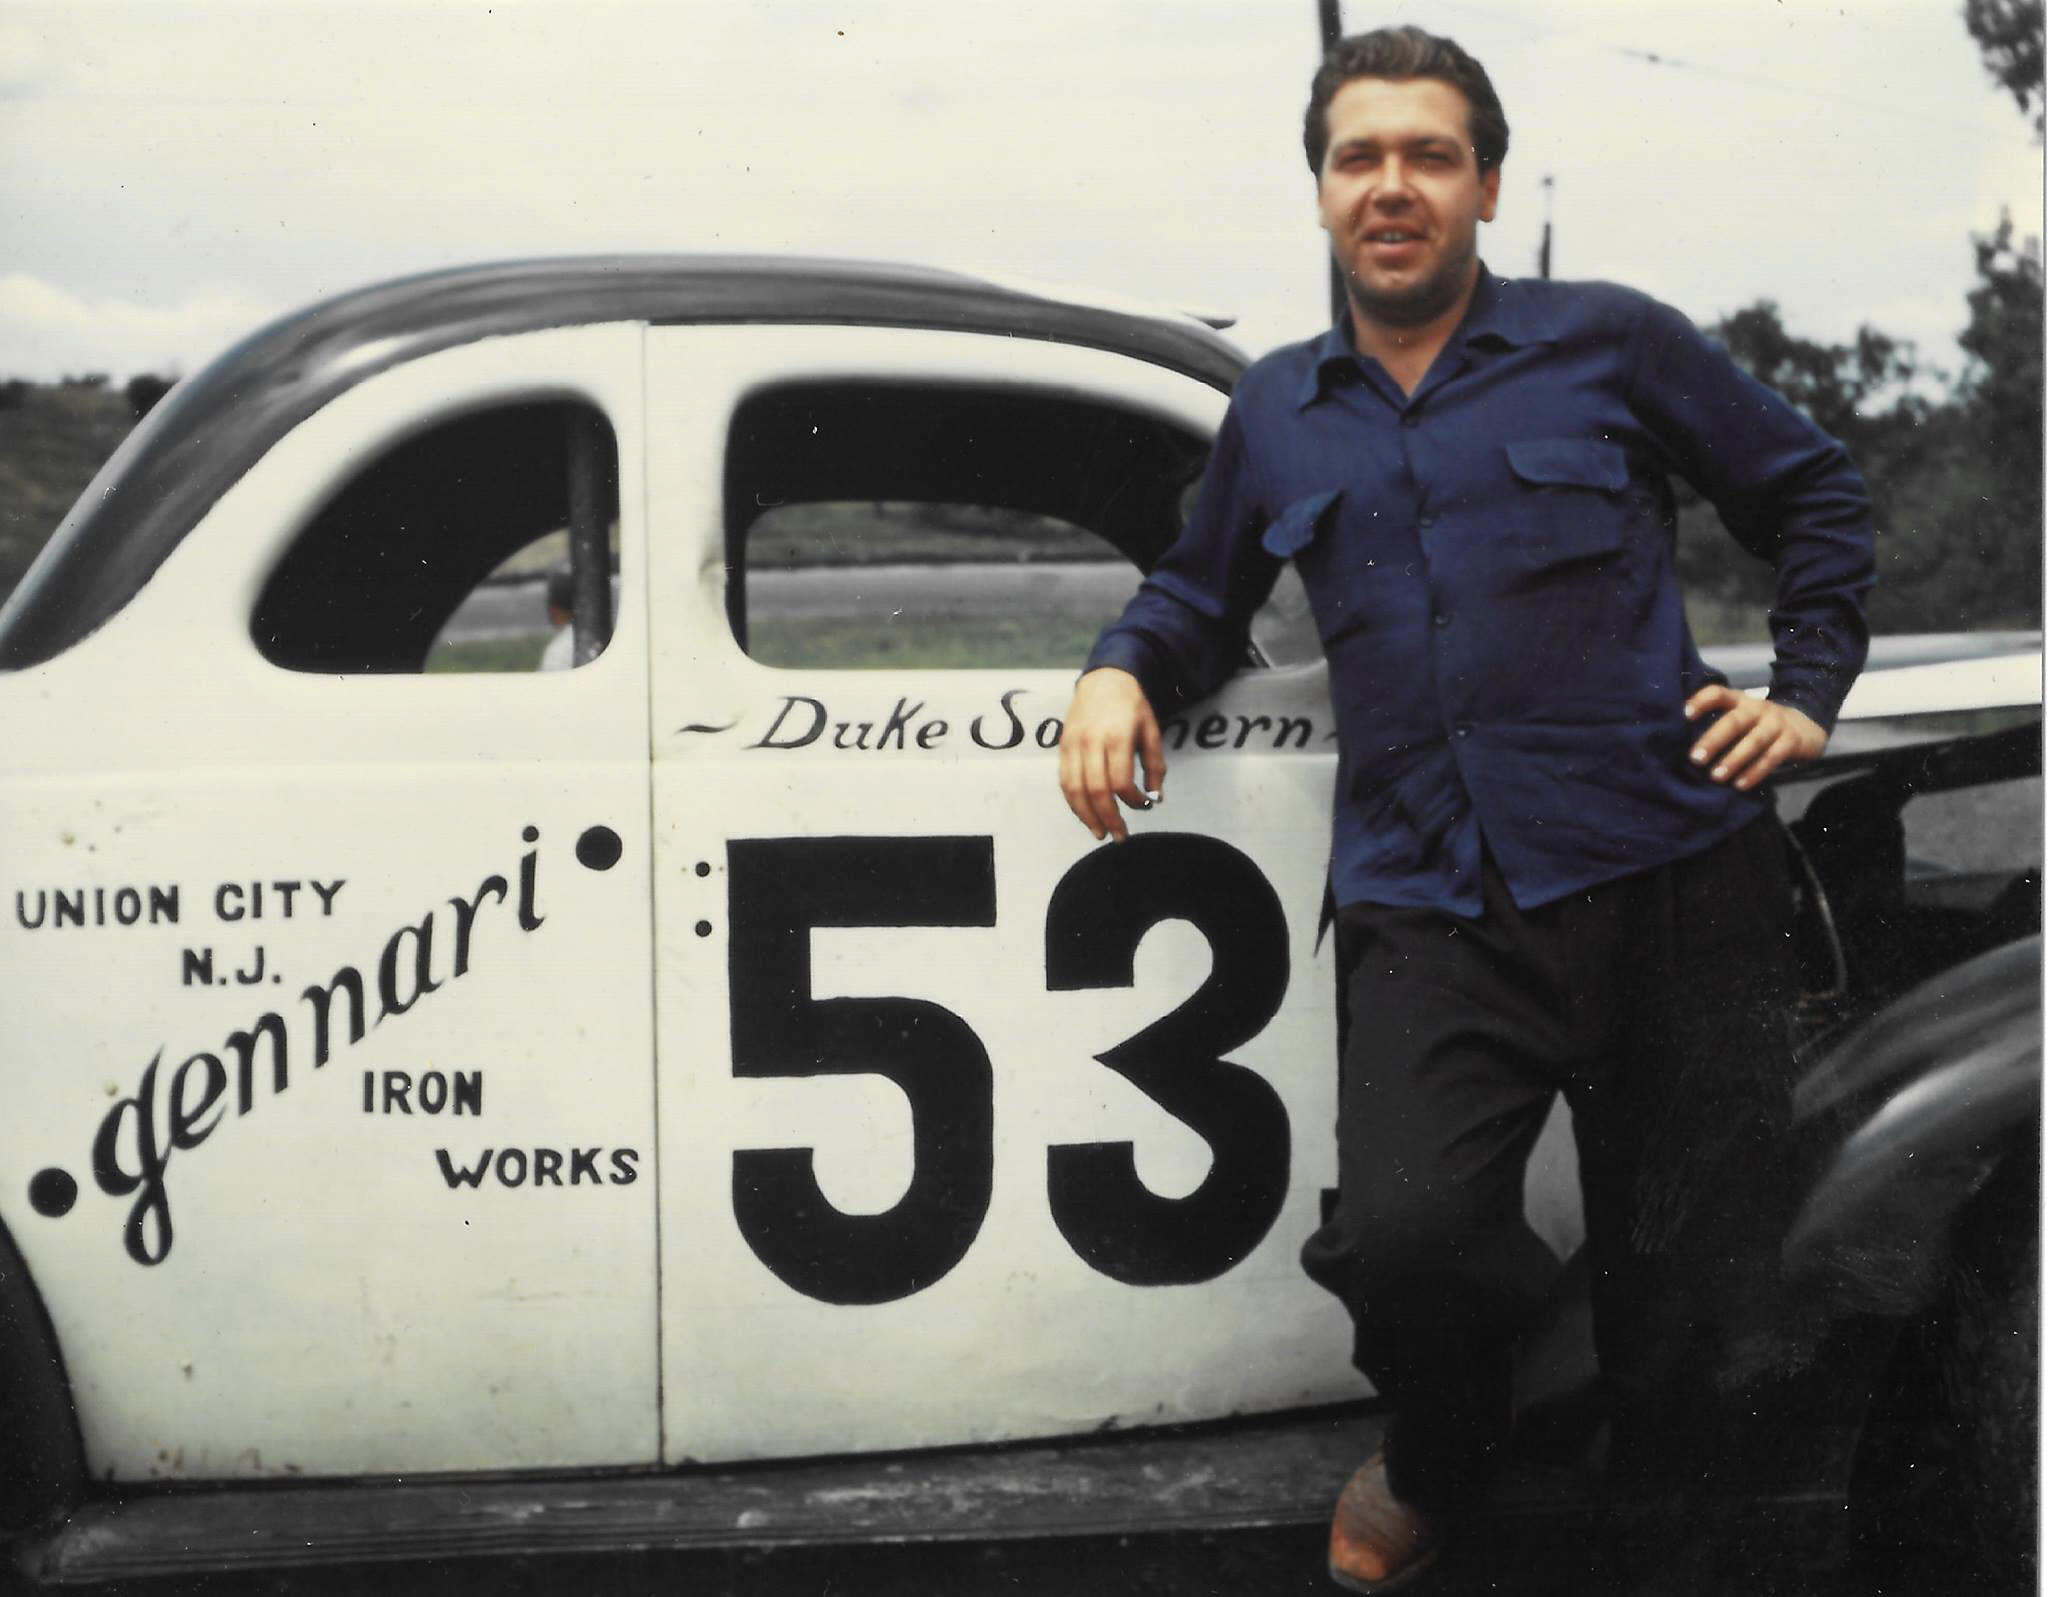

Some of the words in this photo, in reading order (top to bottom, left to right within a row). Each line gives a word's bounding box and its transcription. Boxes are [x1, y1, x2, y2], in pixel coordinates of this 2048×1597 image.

[748, 694, 949, 751] Duke
[969, 688, 1312, 751] Soern
[16, 884, 180, 930] UNION
[214, 879, 347, 923] CITY
[182, 946, 282, 986] N.J.
[92, 825, 546, 1267] gennari
[726, 831, 1336, 1306] 53
[362, 1070, 484, 1117] IRON
[435, 1146, 640, 1190] WORKS
